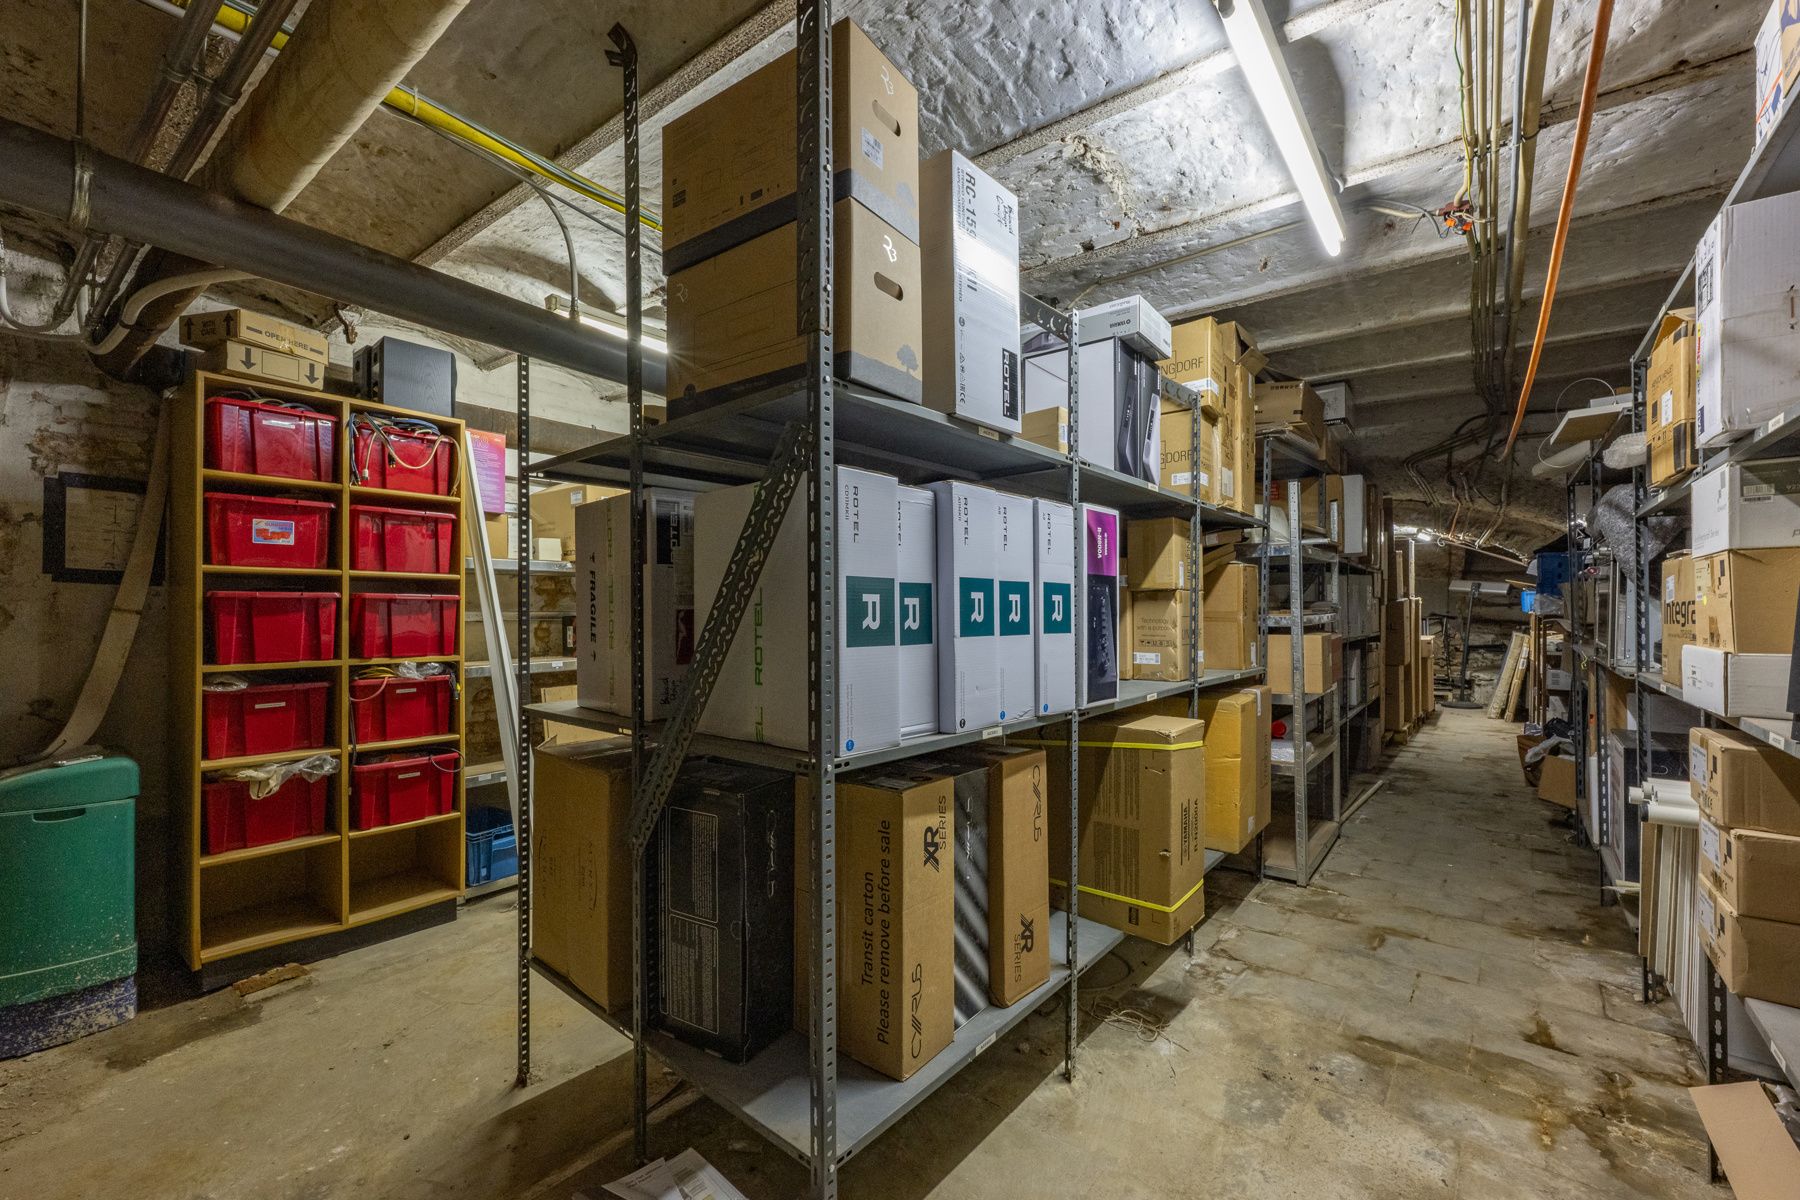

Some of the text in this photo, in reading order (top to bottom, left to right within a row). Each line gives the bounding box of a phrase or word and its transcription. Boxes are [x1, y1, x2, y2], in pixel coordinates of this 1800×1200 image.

[1003, 350, 1011, 416] ROTEL
[1161, 356, 1205, 376] NGDORF
[1160, 449, 1193, 465] GDORF
[852, 485, 860, 544] ROTEL
[589, 570, 597, 644] FRAGILE
[862, 593, 882, 631] R
[904, 597, 920, 631] R
[970, 592, 985, 624] R
[1008, 594, 1021, 624] R
[1051, 595, 1063, 623] R
[753, 586, 764, 687] ROTEL
[938, 795, 947, 850] SERIES
[923, 825, 940, 873] XR
[861, 871, 874, 987] Transit carton
[876, 819, 891, 1045] Please remove before sale
[1019, 913, 1034, 954] XR
[1014, 933, 1022, 984] SERIES
